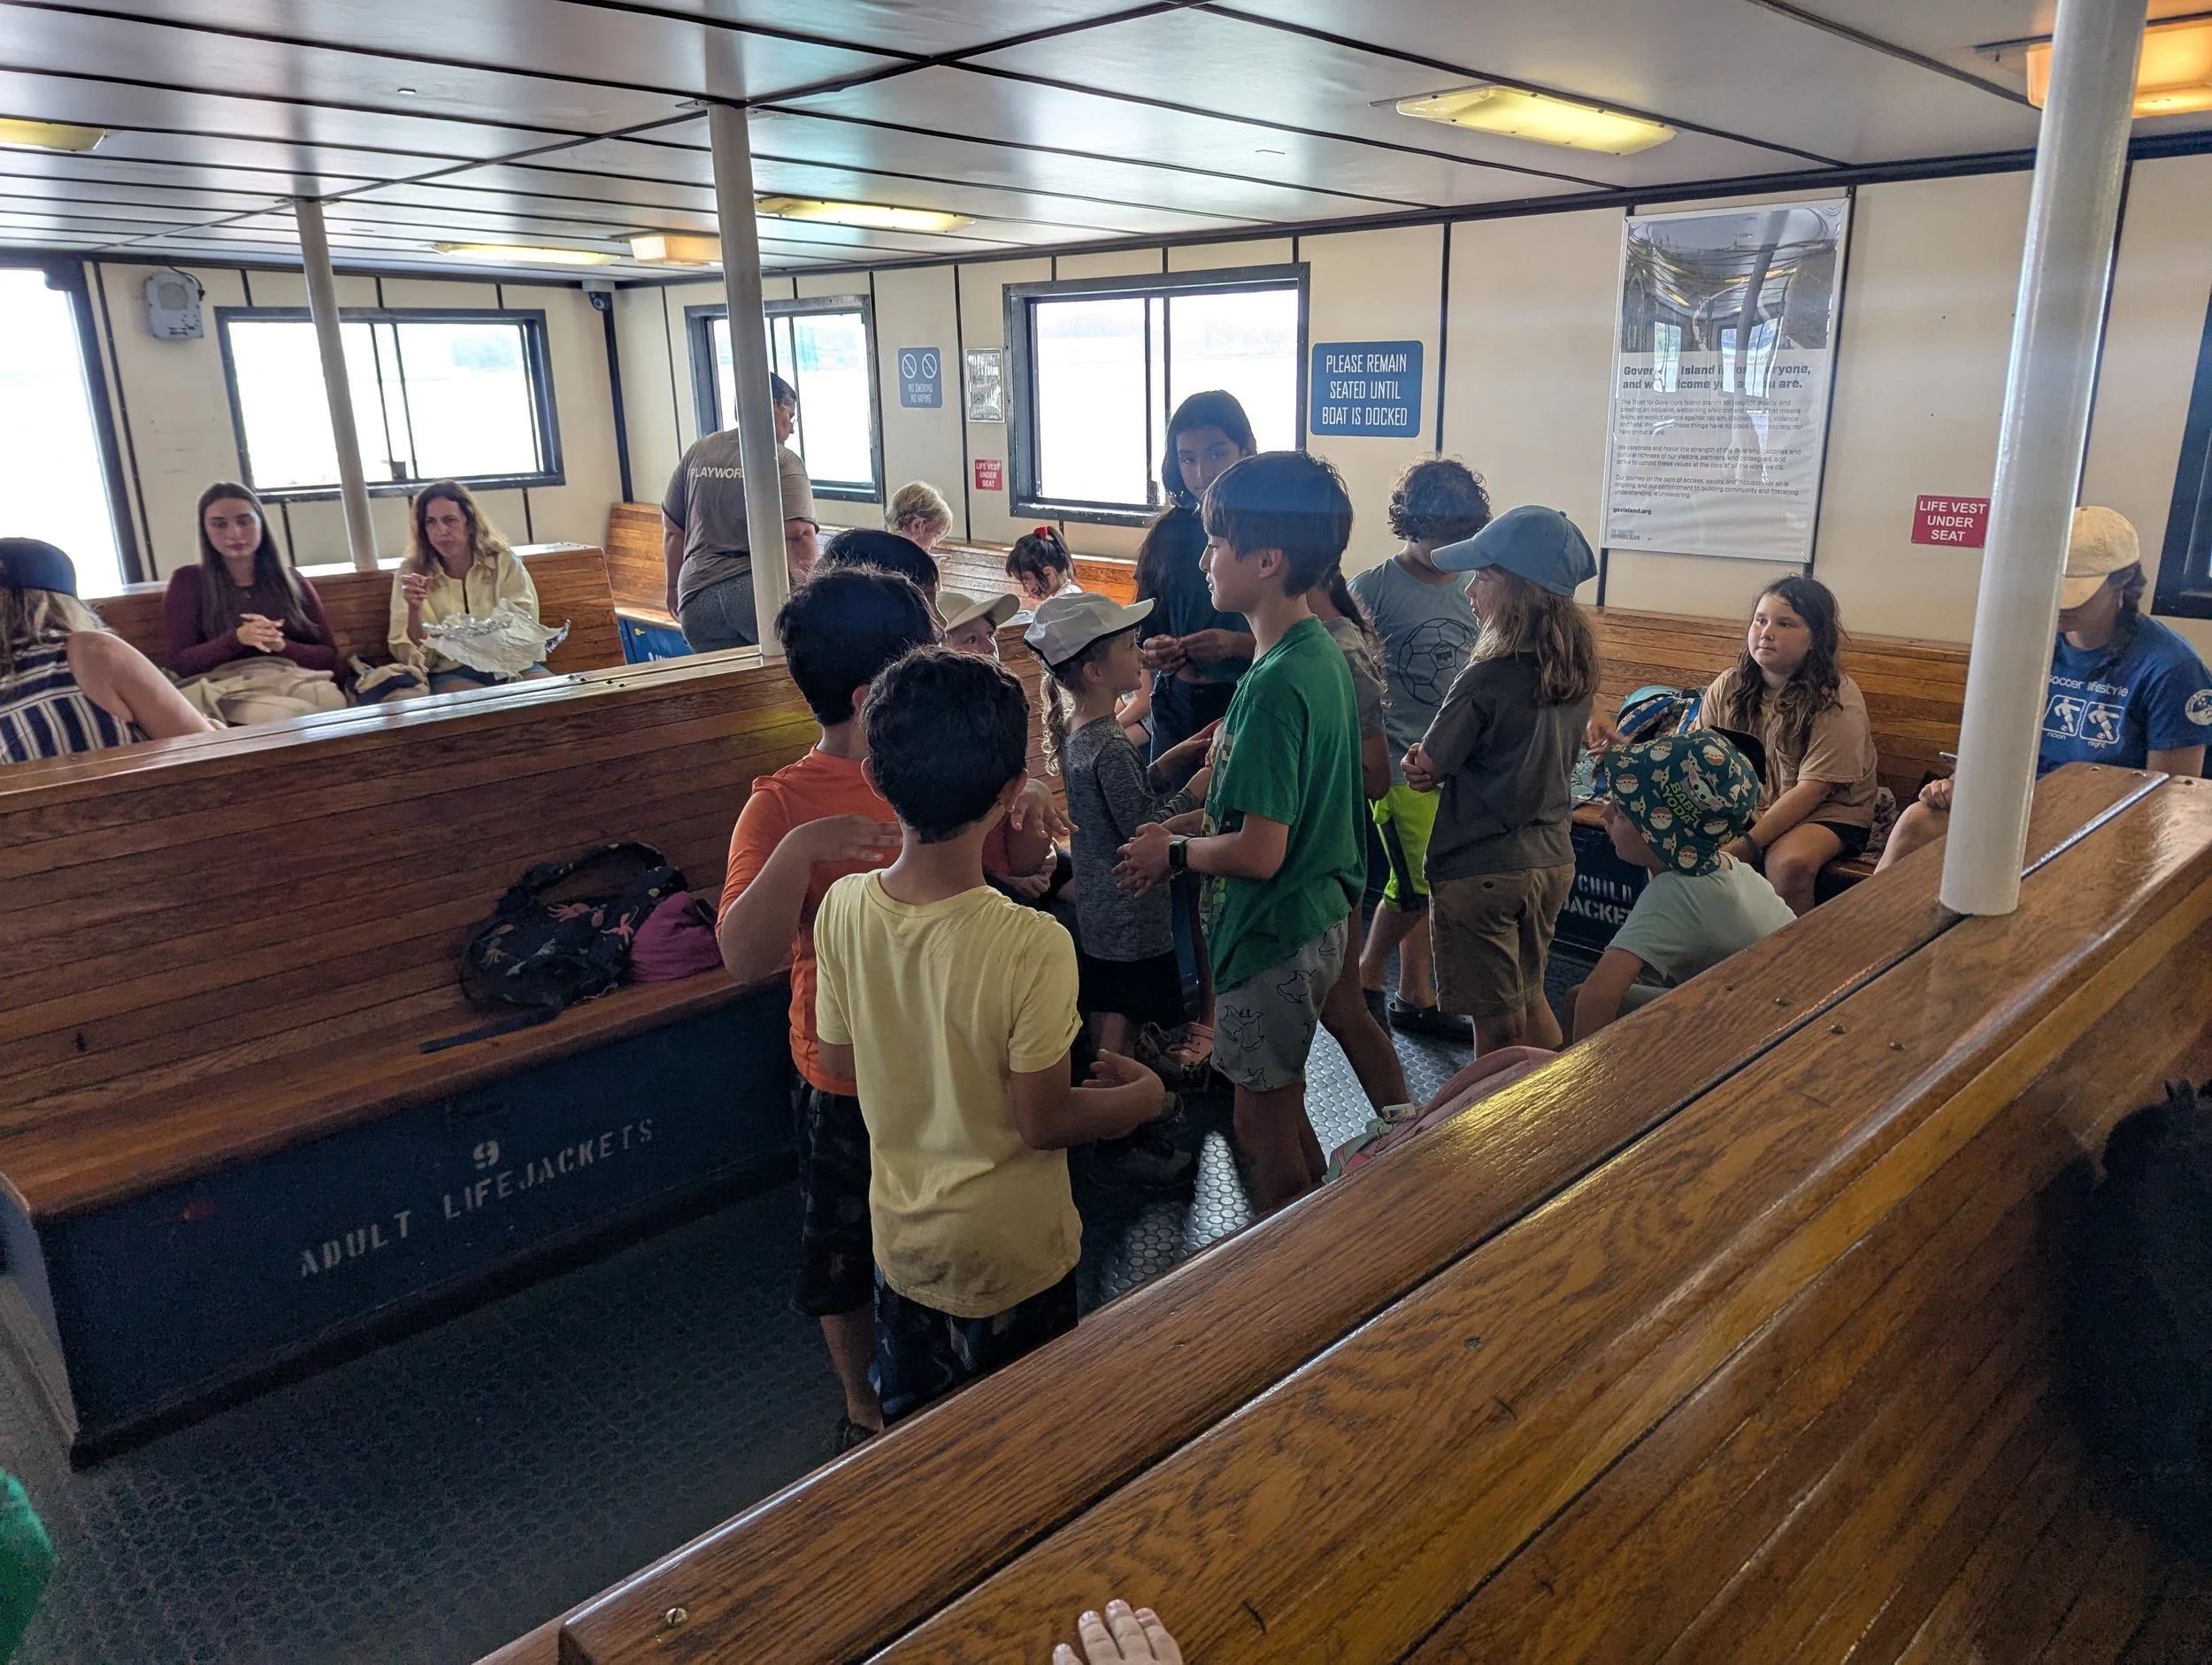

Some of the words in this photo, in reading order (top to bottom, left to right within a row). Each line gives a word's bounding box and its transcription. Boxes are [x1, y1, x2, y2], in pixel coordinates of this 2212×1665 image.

[1326, 354, 1363, 372] PLEASE
[1367, 353, 1407, 372] REMAIN
[1624, 365, 1655, 376] Gover
[1680, 364, 1716, 375] Island
[908, 383, 914, 393] NO
[1330, 380, 1366, 399] SEATED
[1371, 380, 1402, 399] UNTIL
[1623, 379, 1642, 388] and
[1677, 379, 1710, 389] lcome
[910, 394, 917, 403] NO
[1322, 406, 1348, 425] BOAT
[1352, 407, 1362, 425] IS
[1365, 407, 1408, 426] DOCKED
[690, 466, 743, 480] PLAYWOR
[1919, 501, 1947, 512] LIFE
[1951, 503, 1986, 514] VEST
[1927, 515, 1974, 528] UNDER
[1931, 530, 1965, 541] SEAT
[2086, 680, 2129, 697] lifestyle
[2047, 731, 2066, 740] noon
[2087, 740, 2107, 749] night
[1663, 785, 1694, 825] YODA
[1669, 781, 1702, 819] BABY
[1578, 874, 1633, 902] CHILD
[473, 1140, 500, 1170] 9
[300, 1209, 411, 1278] ADULT
